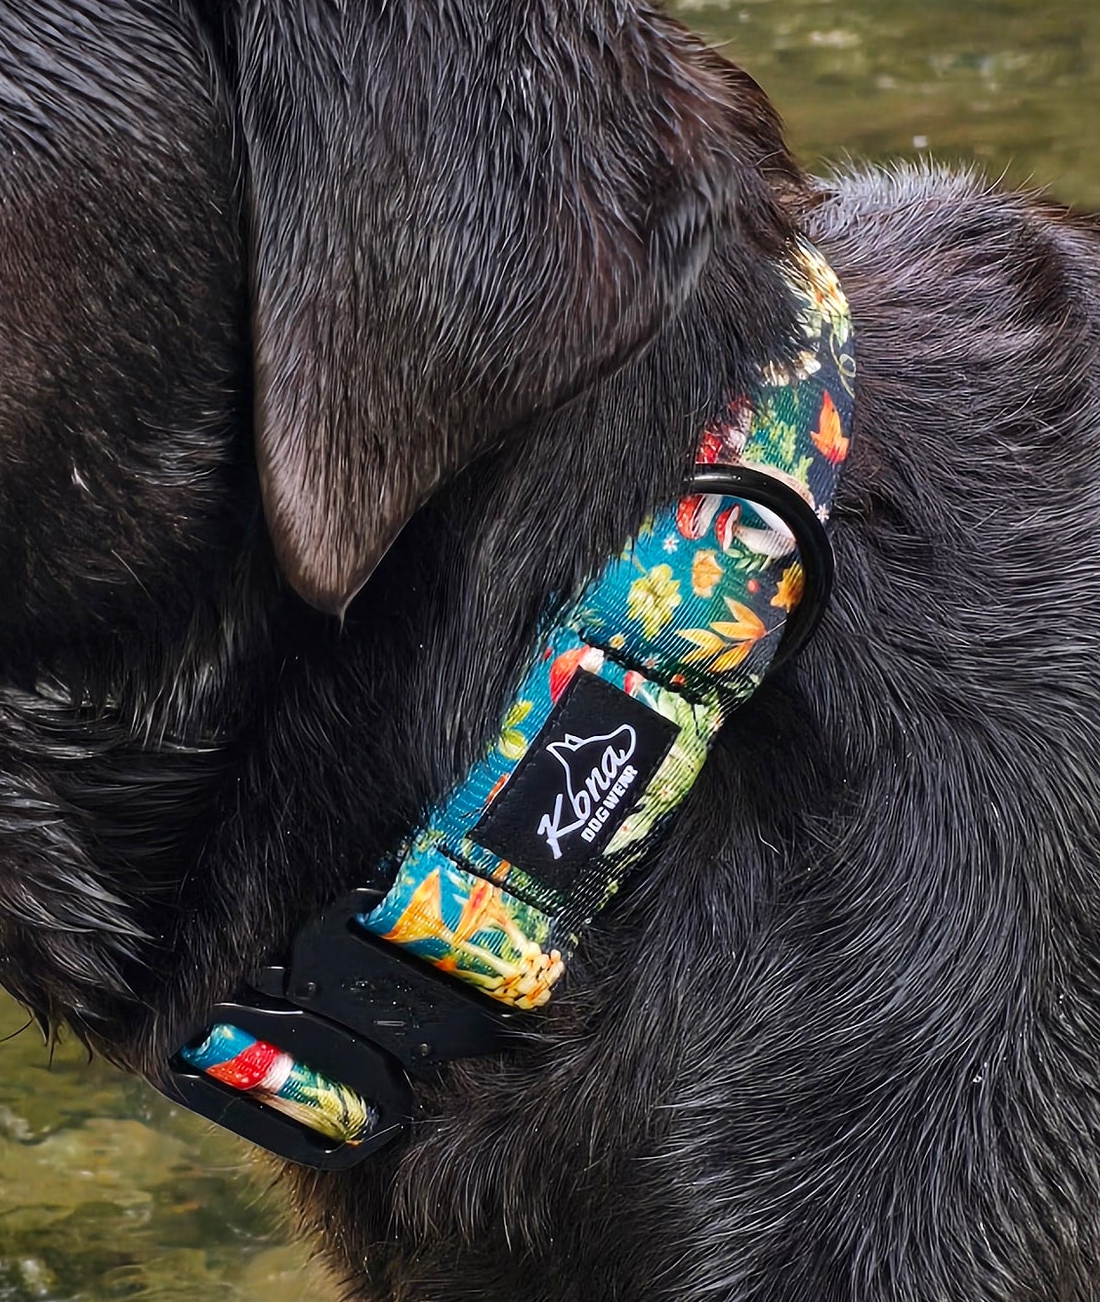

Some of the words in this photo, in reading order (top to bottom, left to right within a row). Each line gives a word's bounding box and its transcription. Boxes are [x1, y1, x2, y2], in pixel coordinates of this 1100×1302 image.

[537, 745, 626, 859] Kona
[581, 806, 610, 842] DOG
[603, 765, 638, 810] WEAR
